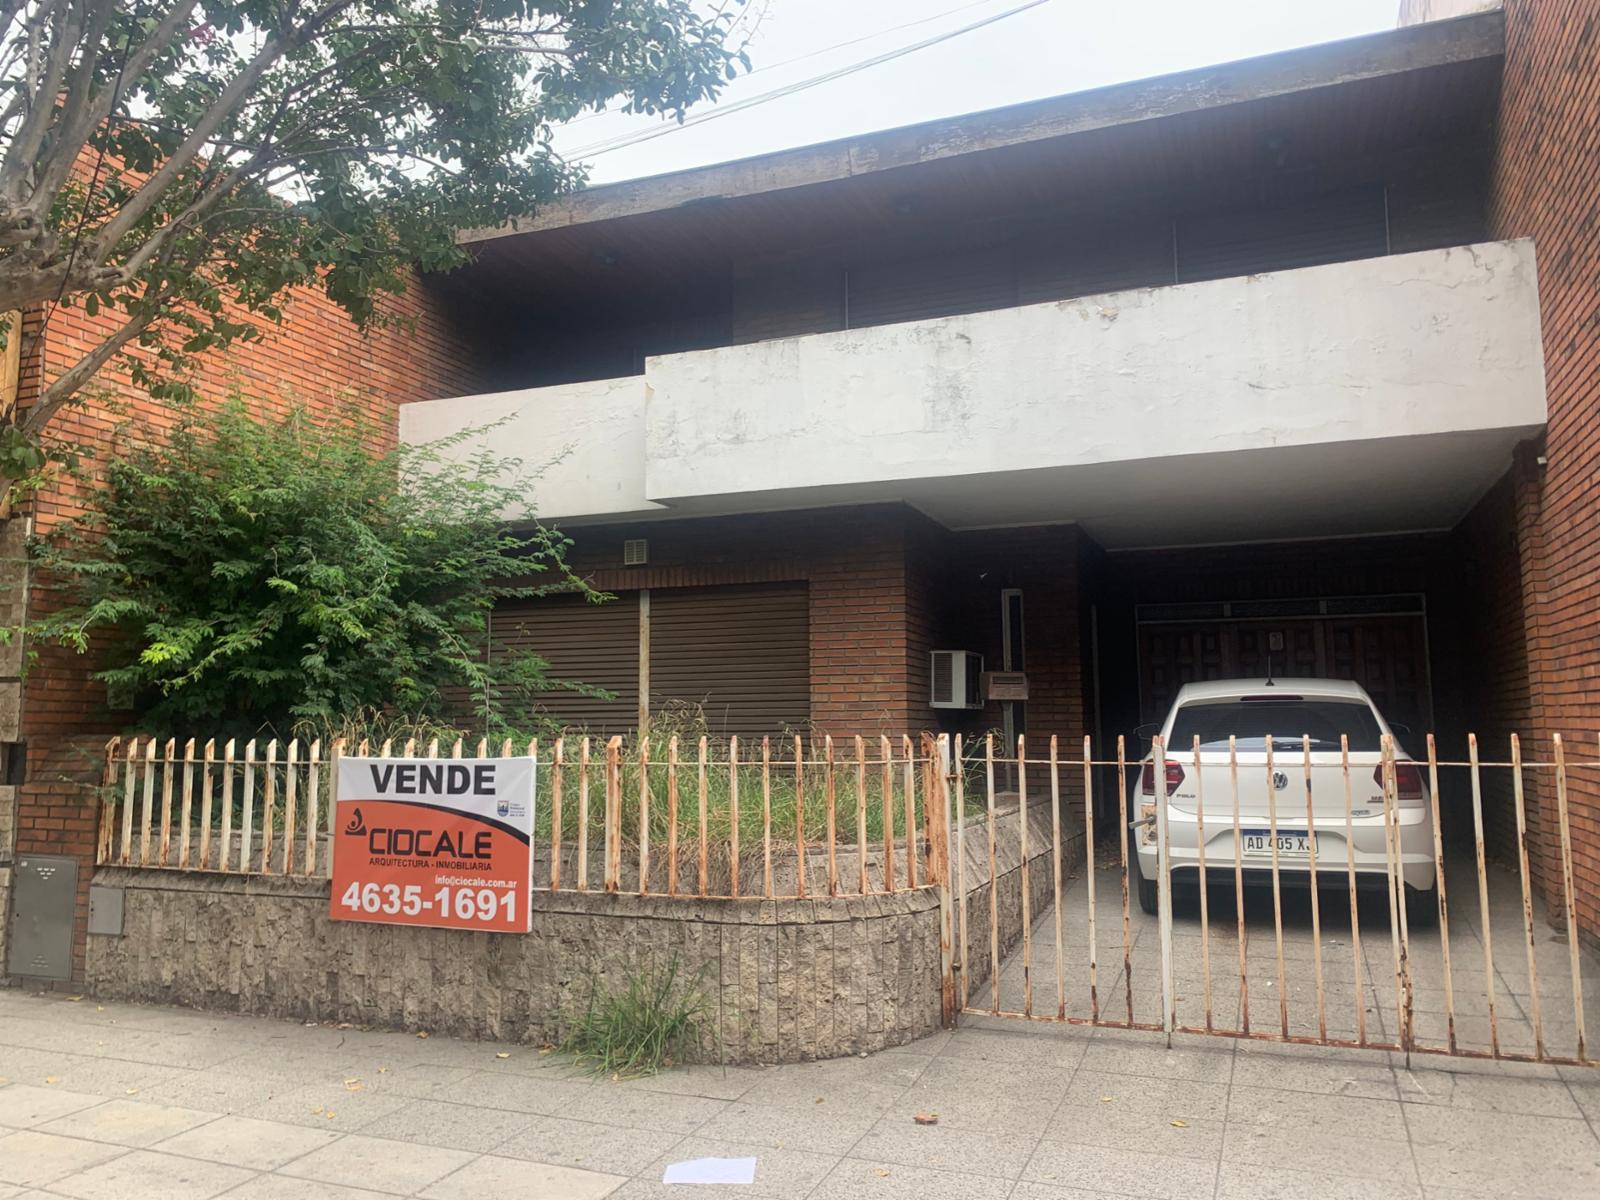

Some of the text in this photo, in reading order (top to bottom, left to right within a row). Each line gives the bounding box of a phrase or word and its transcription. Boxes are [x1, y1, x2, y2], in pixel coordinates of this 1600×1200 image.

[370, 764, 496, 795] VENDE
[369, 828, 492, 859] CIOCALE
[1247, 837, 1263, 850] AD
[369, 858, 429, 868] ARQUITECTURA
[436, 860, 492, 871] INMOBILIARIA
[434, 874, 517, 889] info@ciocale.com.ar
[341, 881, 516, 922] 4635-1691
